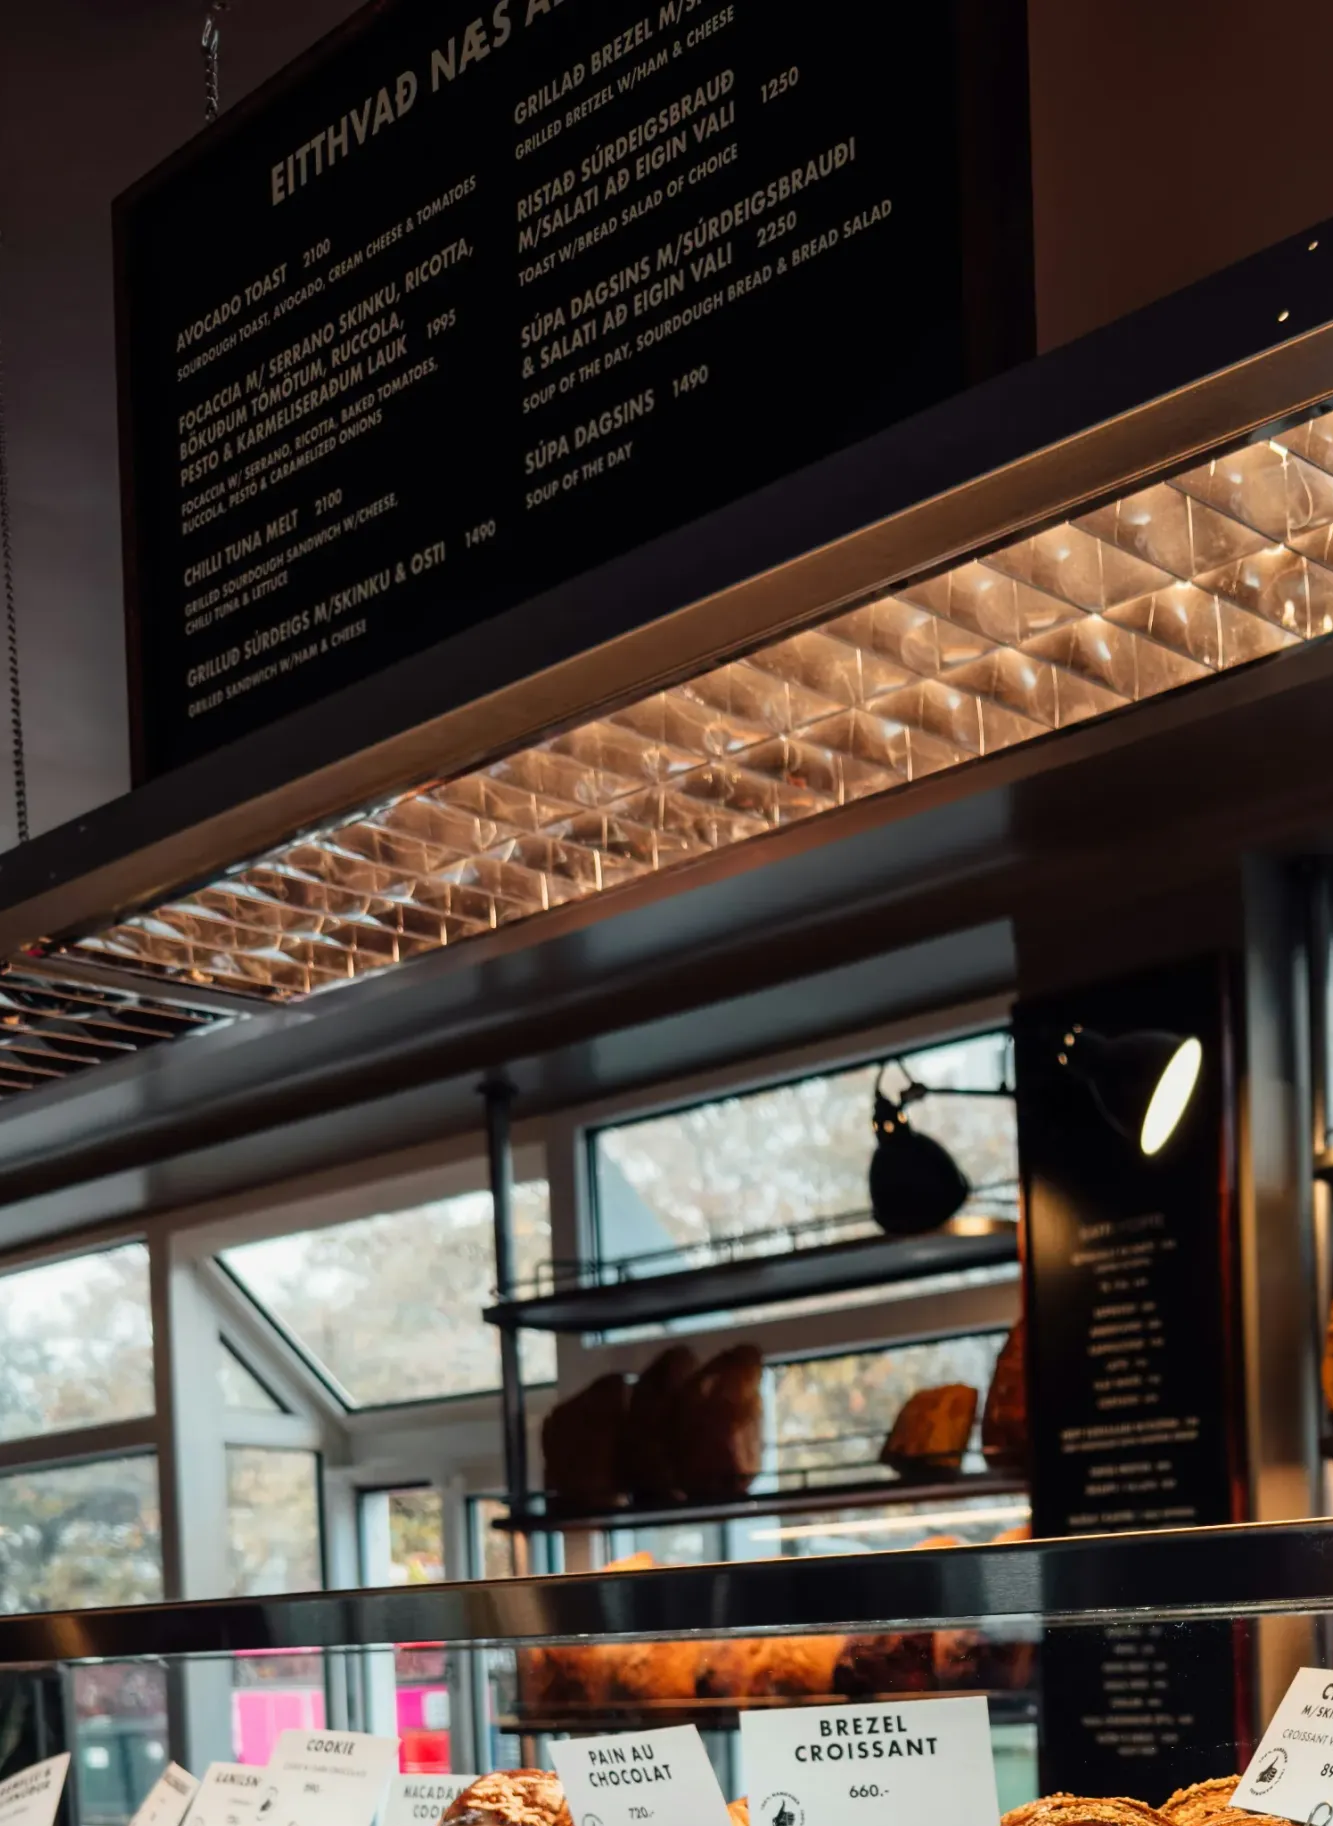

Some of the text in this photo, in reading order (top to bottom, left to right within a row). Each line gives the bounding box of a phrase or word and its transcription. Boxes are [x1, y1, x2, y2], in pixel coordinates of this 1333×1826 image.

[272, 0, 511, 206] EITTHVAÐ NÆS
[515, 0, 703, 124] GRILLAÐ BREZEL M/S
[516, 5, 734, 160] GRILLED BRETZEL W/HAM & CHEESE
[518, 70, 734, 222] RISTAÐ SÚRDEIGSBRAUÐ
[519, 66, 798, 253] M/SALATI AÐ EIGIN VALI 1250
[519, 143, 737, 286] TOAST W/BREAD SALAD OF CHOICE
[522, 137, 855, 348] SÚPA DAGSINS M/SÚRDEIGSBRAUÐI
[177, 238, 331, 352] AVOCADO TOAST 2100
[178, 175, 476, 382] SOURDOUGH TOAST, AVOCADO, CREAM CHEESE & TOMATOES
[179, 238, 473, 434] FOCACCIA M/ SERRANO SKINKU, RICOTTA,
[522, 211, 796, 379] & SALATI AÐ EIGIN VALI 2250
[523, 200, 891, 413] SOUP OF THE DAY, SOURDOUGH BREAD & BREAD SALAD
[181, 451, 219, 487] PESTO
[223, 443, 233, 462] &
[368, 334, 407, 375] LAUK
[427, 309, 455, 338] 1995
[332, 312, 404, 368] RUCCOLA,
[526, 365, 708, 474] SÚPA DAGSINS 1490
[526, 442, 632, 509] SOUP OF THE DAY
[184, 488, 342, 587] CHILLI TUNA MELT 2100
[244, 610, 310, 659] SÚRDEIGS
[314, 569, 390, 624] M/SKINKU
[395, 562, 406, 583] &
[411, 541, 445, 574] OSTI
[465, 520, 495, 547] 1490
[306, 1739, 355, 1756] COOKIE
[588, 1744, 654, 1765] PAIN AU
[588, 1764, 672, 1788] CHOCOLAT
[795, 1737, 937, 1763] CROISSANT
[819, 1715, 907, 1737] BREZEL
[1282, 1728, 1329, 1745] CROISSANT
[628, 1806, 655, 1820] 720.-
[849, 1784, 889, 1799] 660.-
